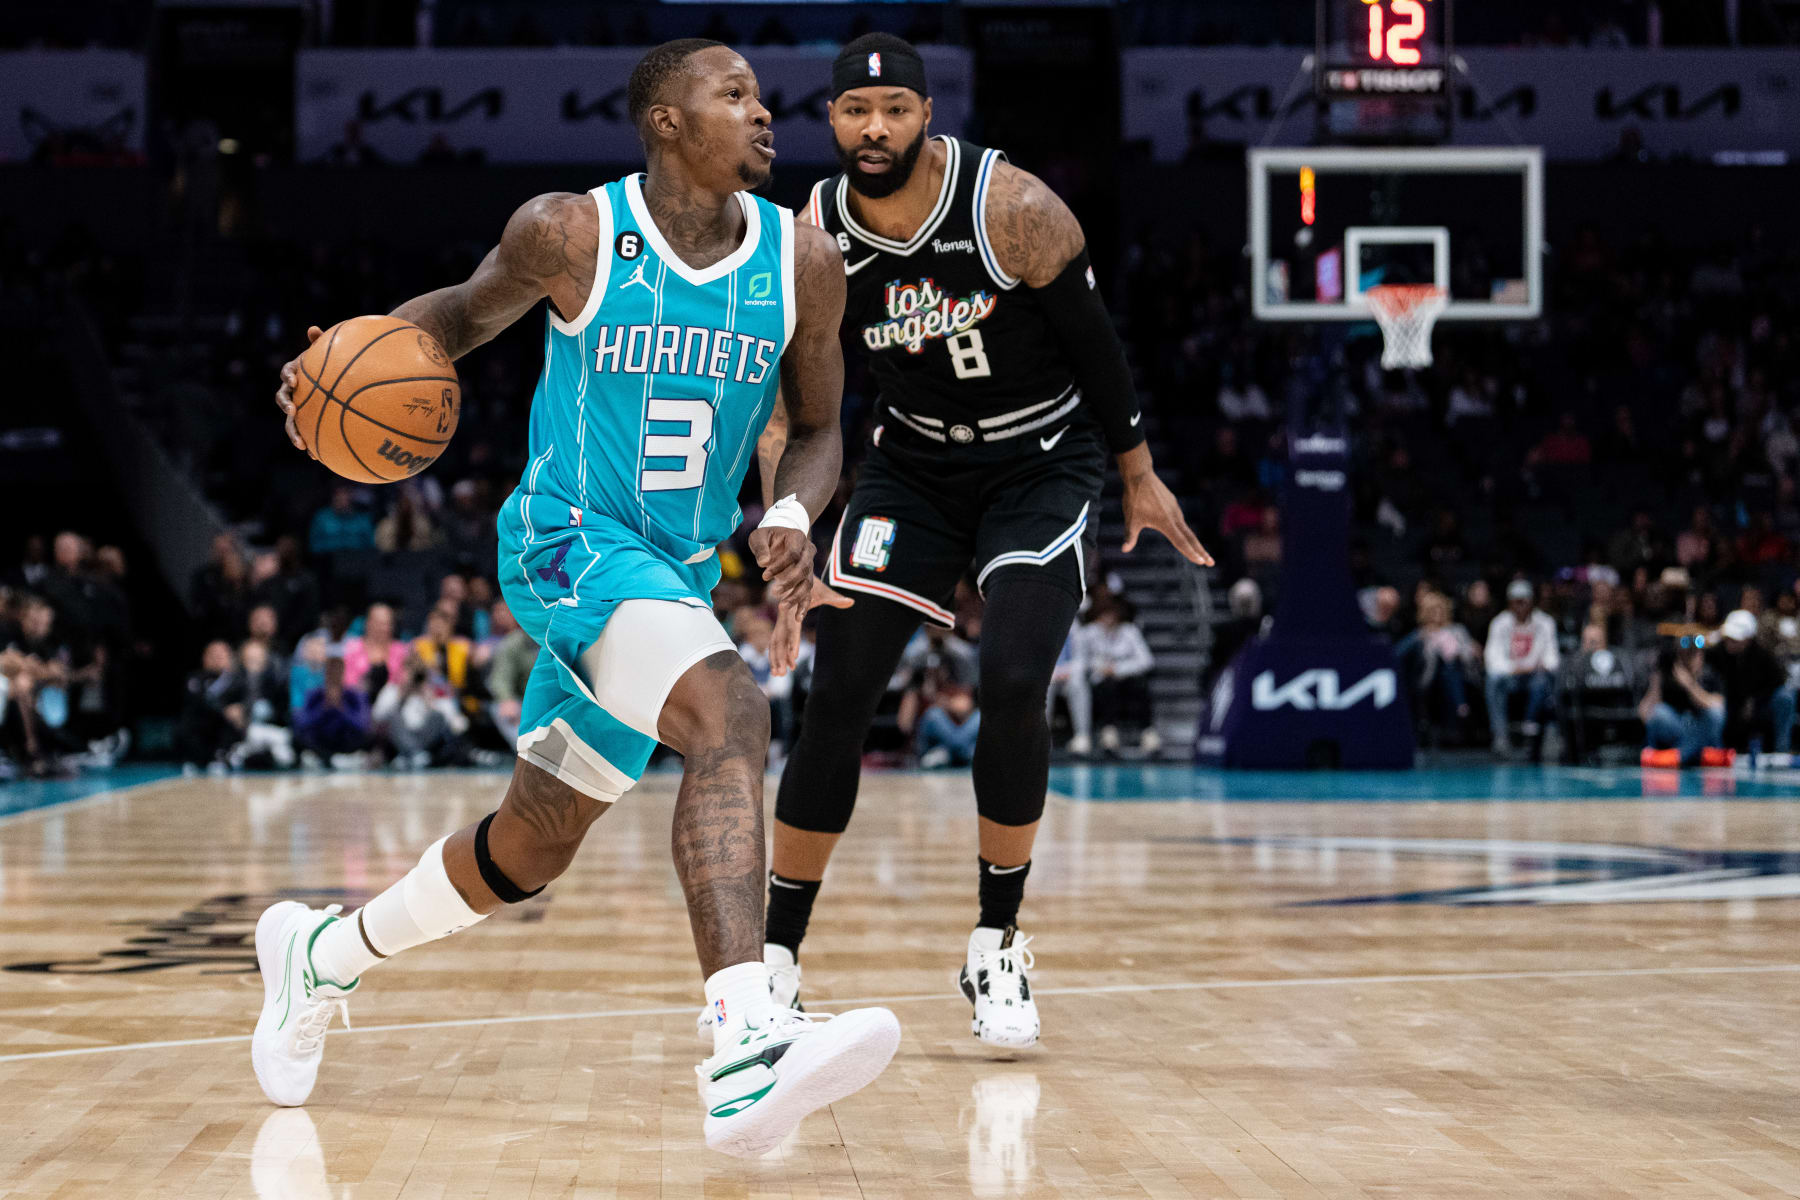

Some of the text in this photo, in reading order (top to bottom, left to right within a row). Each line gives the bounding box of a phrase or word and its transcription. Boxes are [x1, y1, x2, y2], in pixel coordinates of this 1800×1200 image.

[1368, 0, 1426, 66] 12
[621, 234, 638, 258] 6
[836, 231, 851, 252] 6
[931, 238, 976, 253] honey
[744, 298, 777, 307] lendingtree
[886, 281, 943, 319] los
[864, 293, 994, 353] angeles
[593, 324, 777, 385] HORNETS
[946, 329, 992, 379] 8
[640, 398, 715, 493] 3
